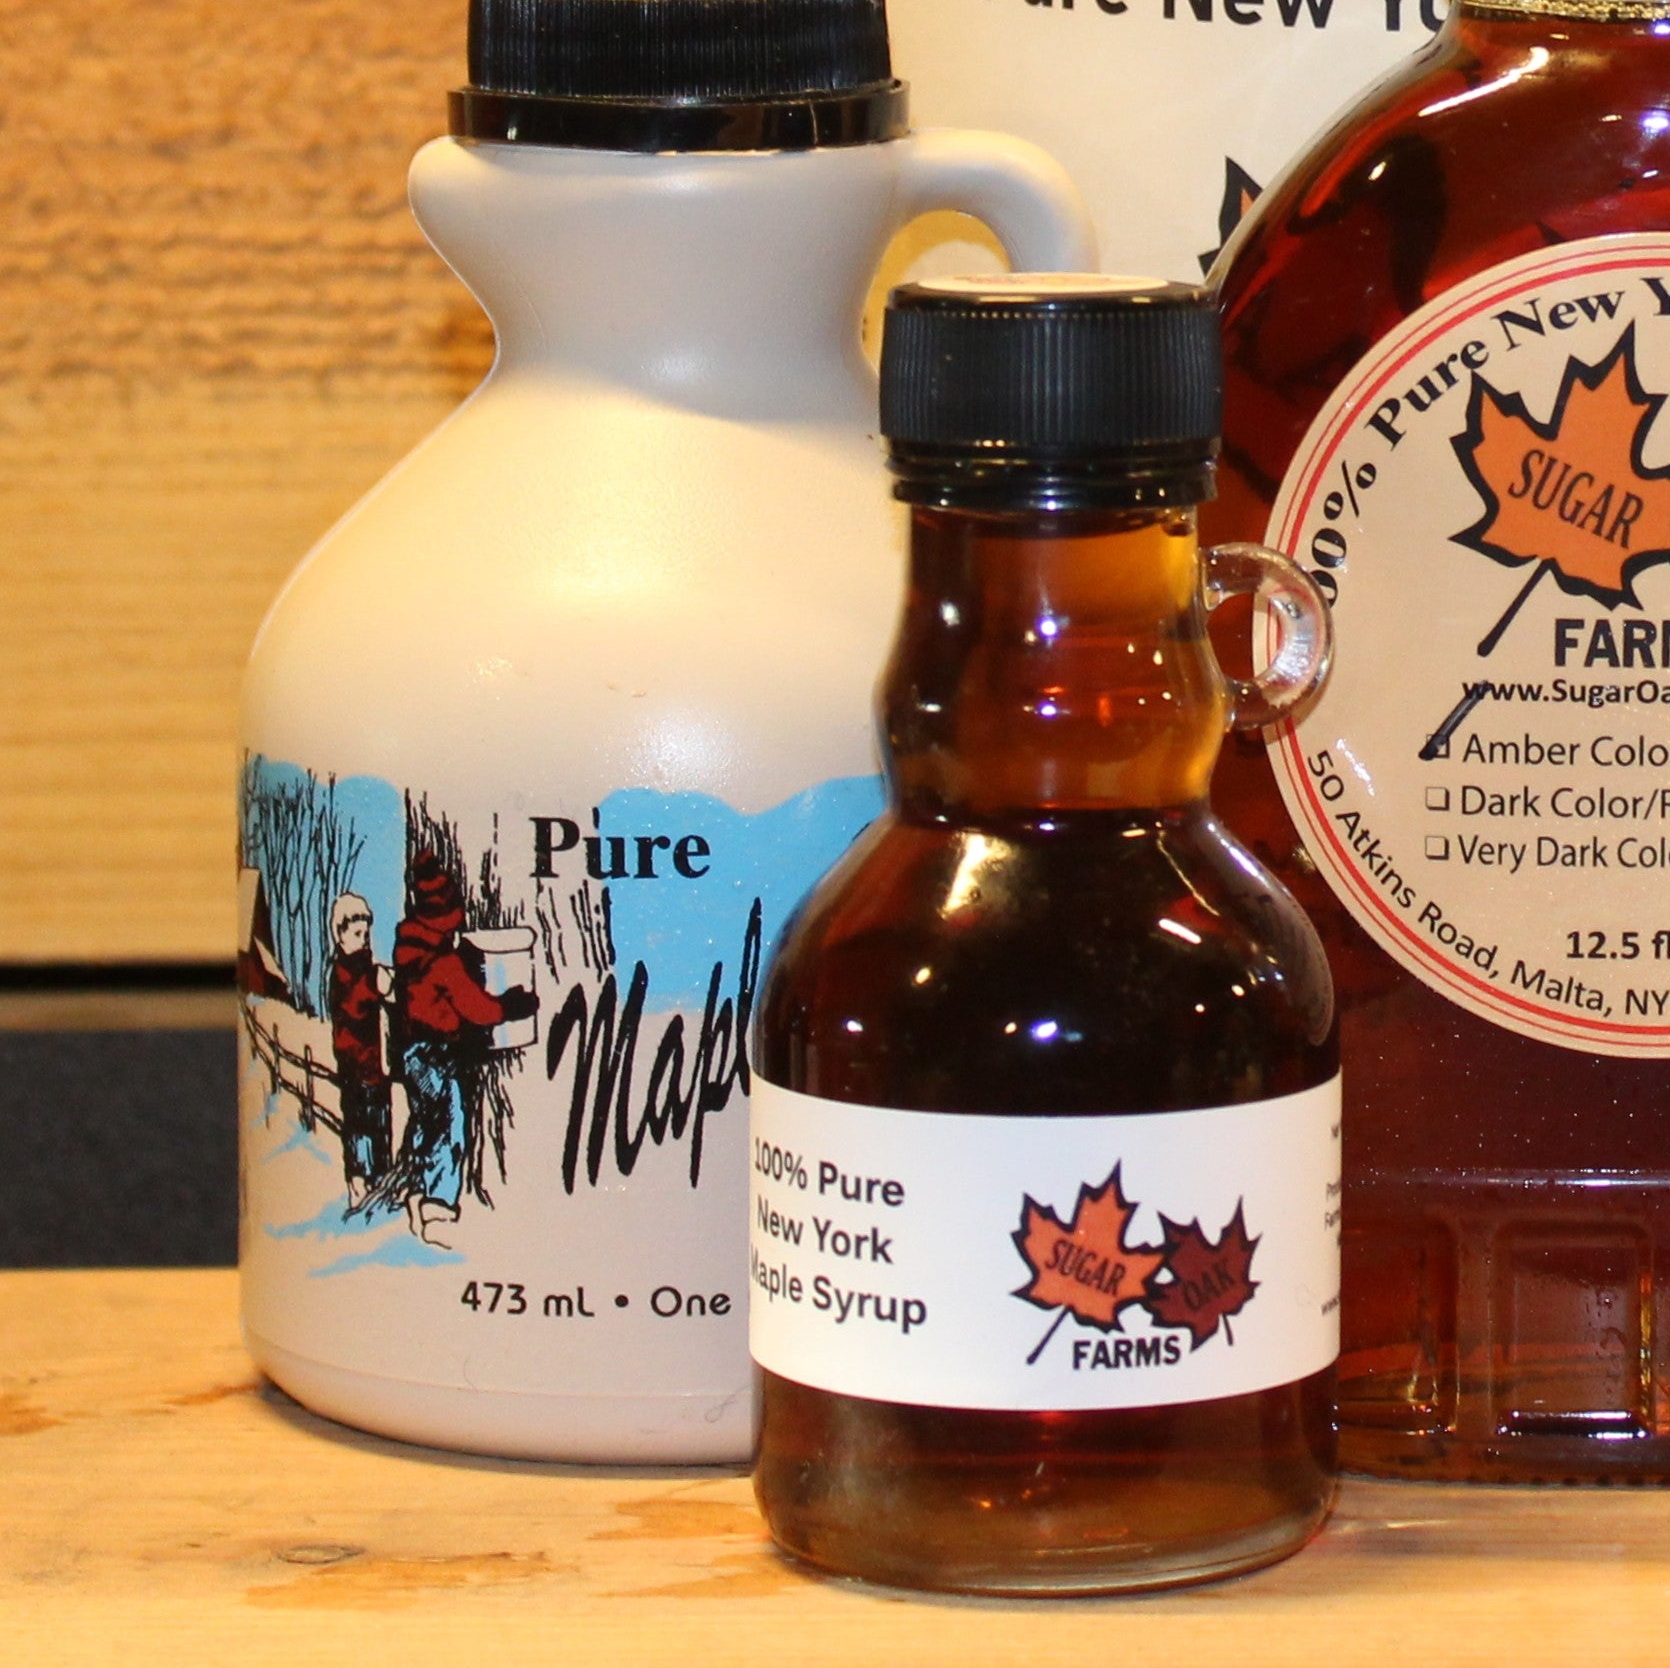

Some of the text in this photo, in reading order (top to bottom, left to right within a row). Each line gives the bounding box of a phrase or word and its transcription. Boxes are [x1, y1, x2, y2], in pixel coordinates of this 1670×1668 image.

[1308, 460, 1378, 612] 00%
[1364, 339, 1490, 451] Pure
[1491, 287, 1626, 351] New
[1508, 448, 1645, 550] SUGAR
[1463, 734, 1581, 770] Amber
[1462, 786, 1541, 819] Dark
[529, 816, 712, 880] Pure
[1458, 838, 1525, 873] Very
[1536, 837, 1608, 869] Dark
[1306, 748, 1346, 802] 50
[1335, 810, 1414, 910] Atkins
[1416, 901, 1502, 981] Road,
[1510, 960, 1613, 1018] Malta,
[1624, 988, 1670, 1016] NY
[1565, 930, 1641, 960] 12.5
[546, 896, 761, 1195] Mapl
[755, 1136, 905, 1207] 100% Pure
[757, 1194, 894, 1265] New York
[460, 1281, 527, 1315] 473
[650, 1285, 732, 1317] One
[812, 1275, 928, 1335] Syrup
[1044, 1236, 1237, 1311] SUGAR OAK
[1072, 1334, 1181, 1371] FARMS
